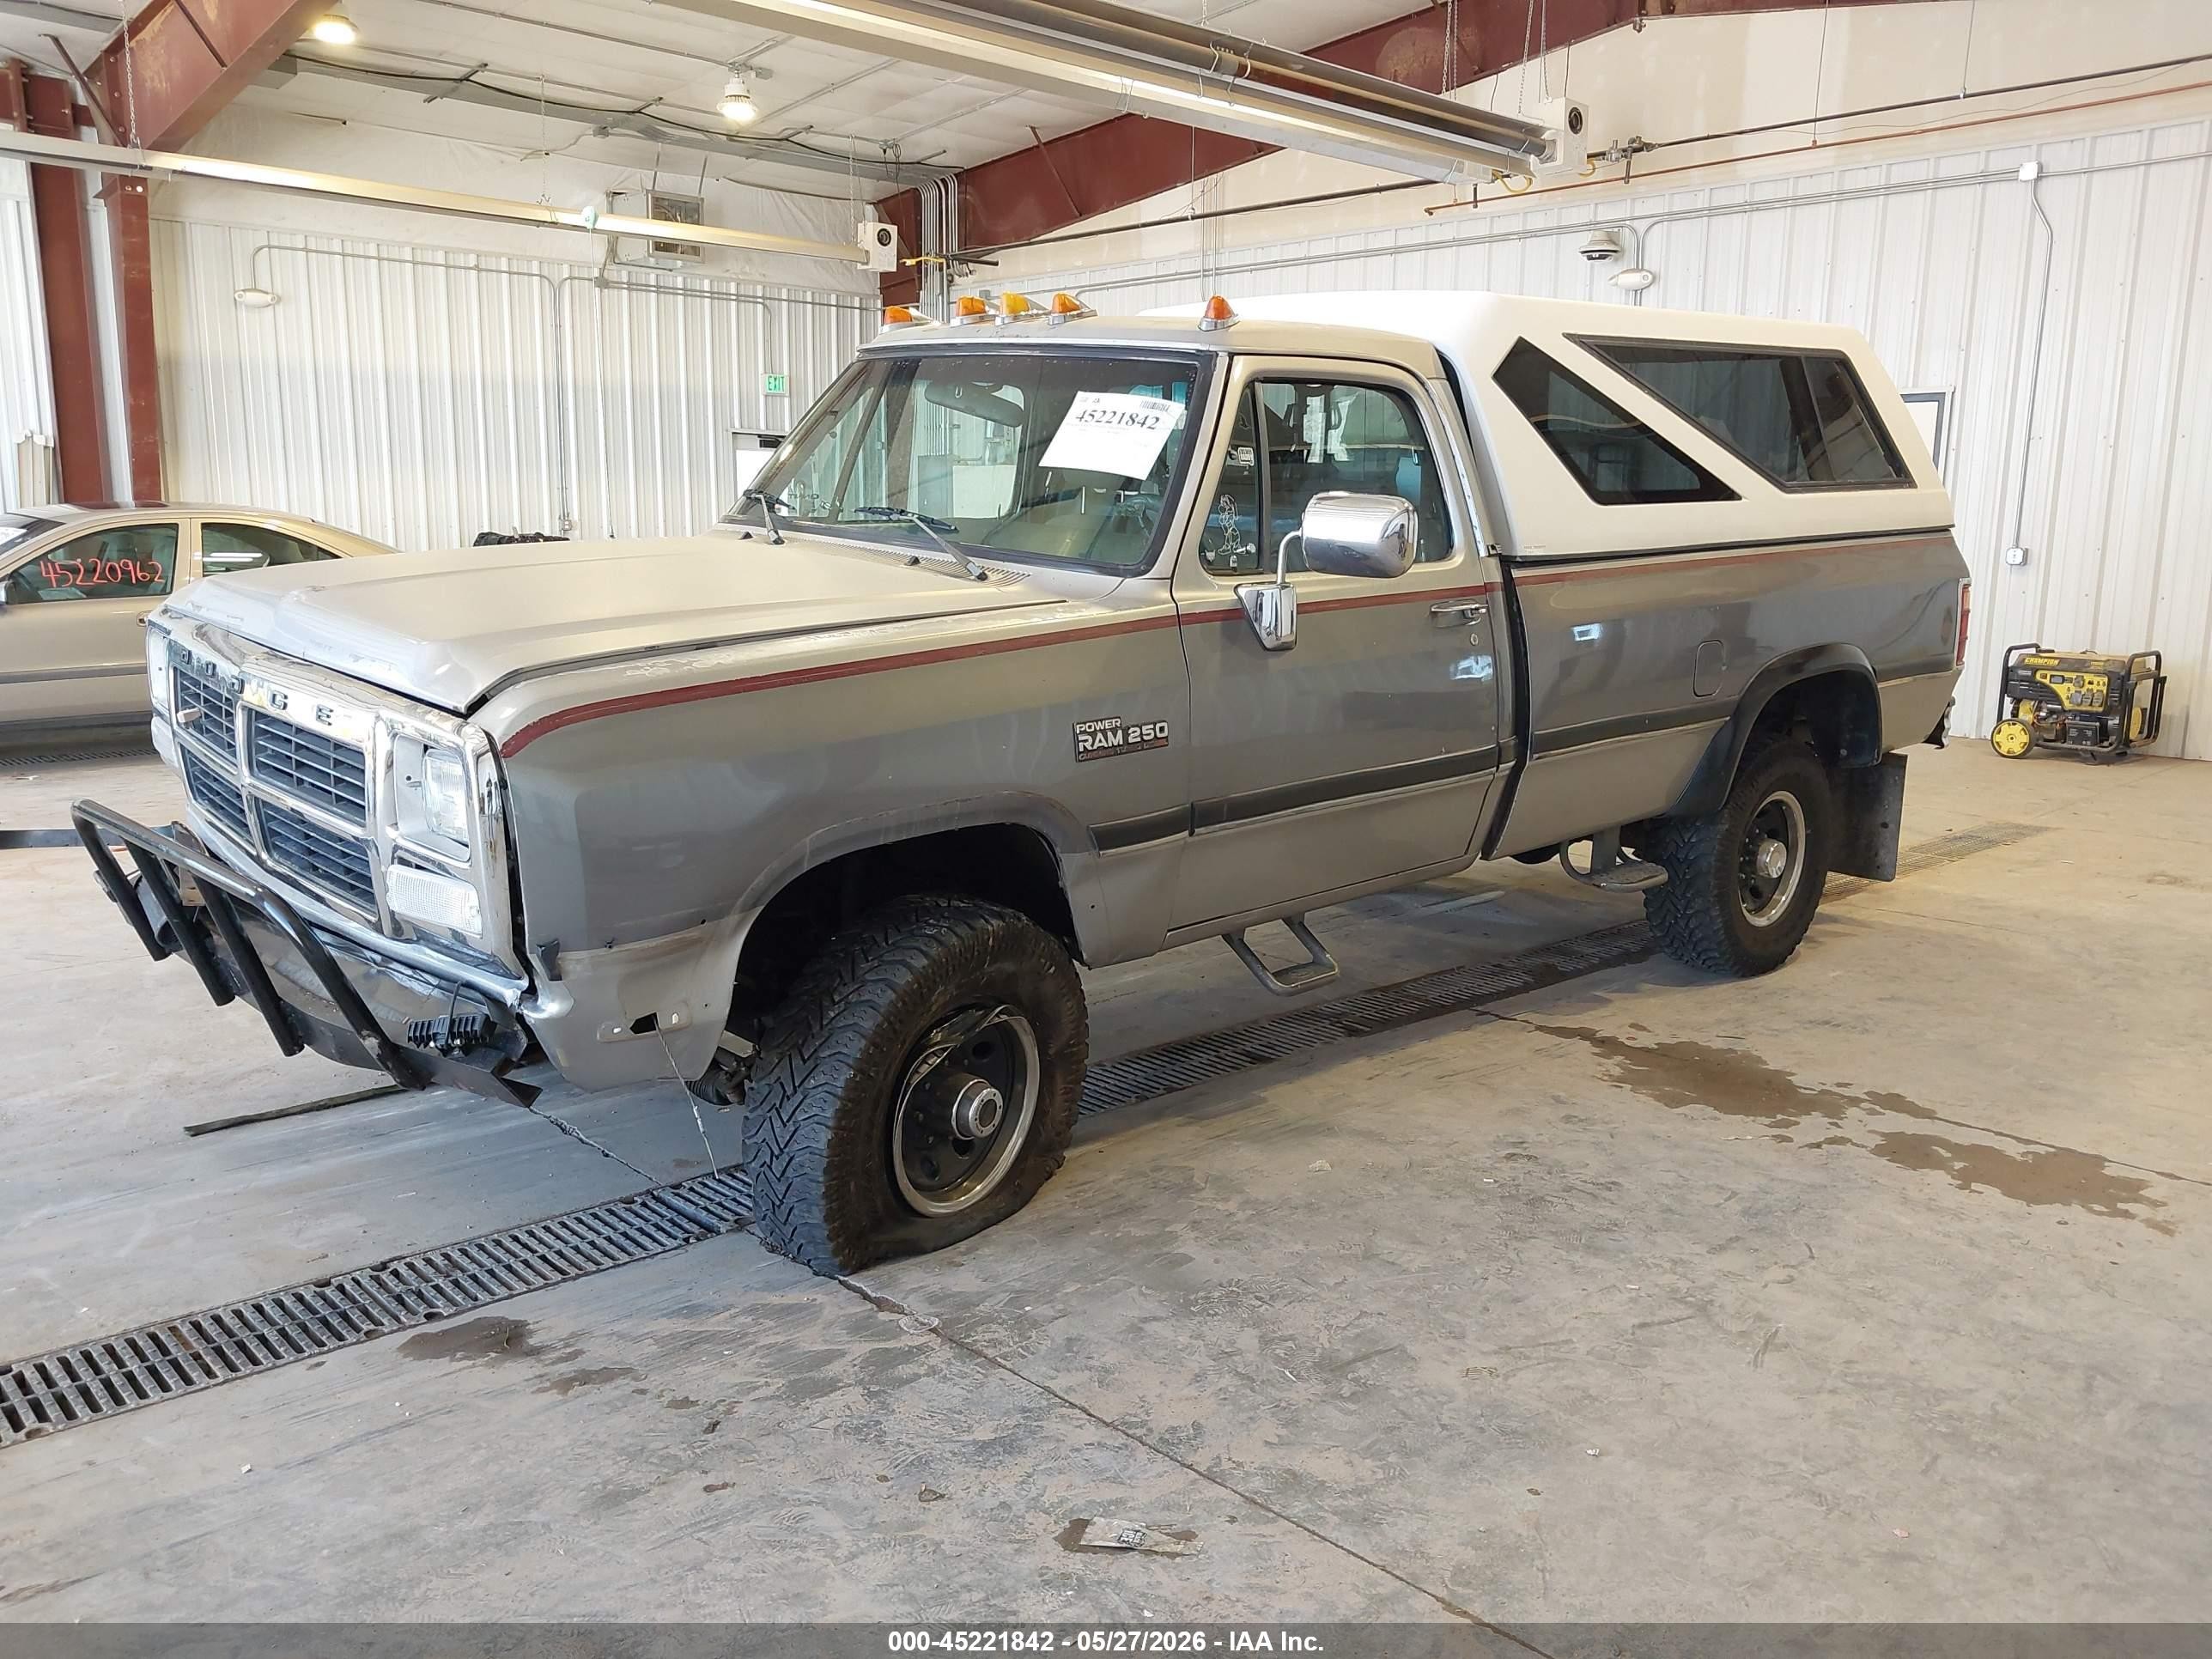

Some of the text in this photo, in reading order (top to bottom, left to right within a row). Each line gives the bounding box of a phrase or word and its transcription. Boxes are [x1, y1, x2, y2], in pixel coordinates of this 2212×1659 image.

[768, 375, 785, 392] EXIT
[1075, 409, 1160, 430] 45221842
[40, 558, 166, 587] 45220962
[2024, 657, 2059, 666] CHAMPION
[1076, 718, 1121, 734] POWER
[1079, 729, 1124, 752] RAM
[1127, 721, 1169, 744] 250
